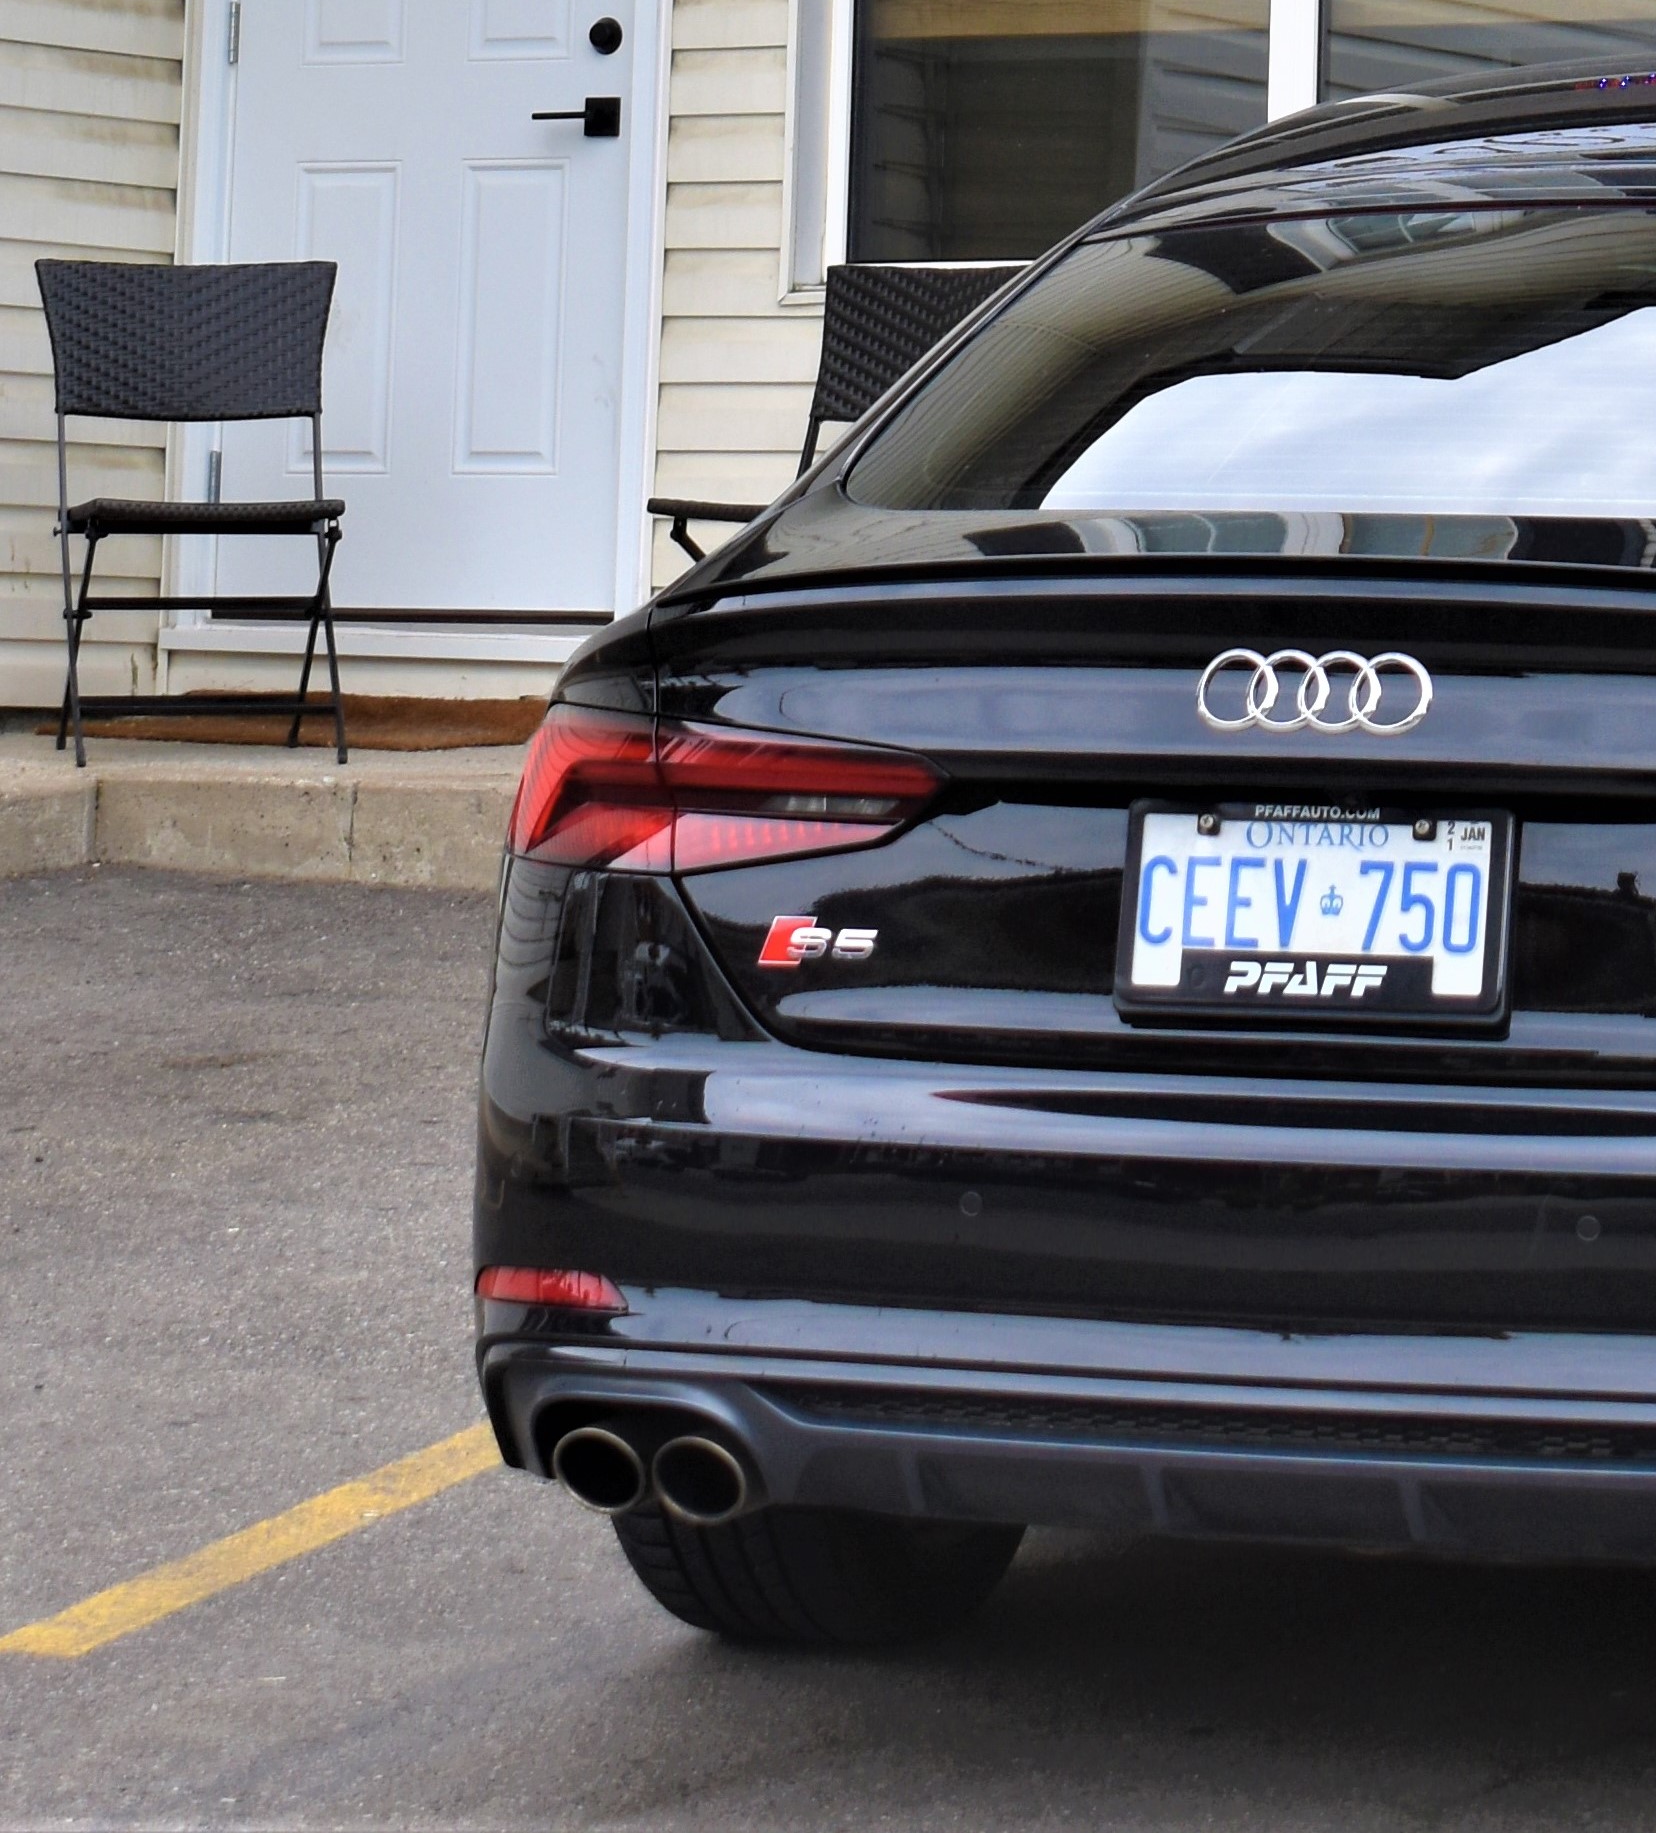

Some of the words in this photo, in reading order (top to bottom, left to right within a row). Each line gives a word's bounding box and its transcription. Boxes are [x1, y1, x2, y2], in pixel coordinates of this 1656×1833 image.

[1255, 805, 1380, 820] PFAFFAUTO.COM
[1246, 821, 1390, 851] ONTARIO
[1460, 827, 1486, 842] JAN
[1140, 855, 1308, 950] CEEV
[1360, 860, 1481, 954] 750
[786, 927, 879, 959] S5
[1223, 961, 1387, 997] PFAFF
